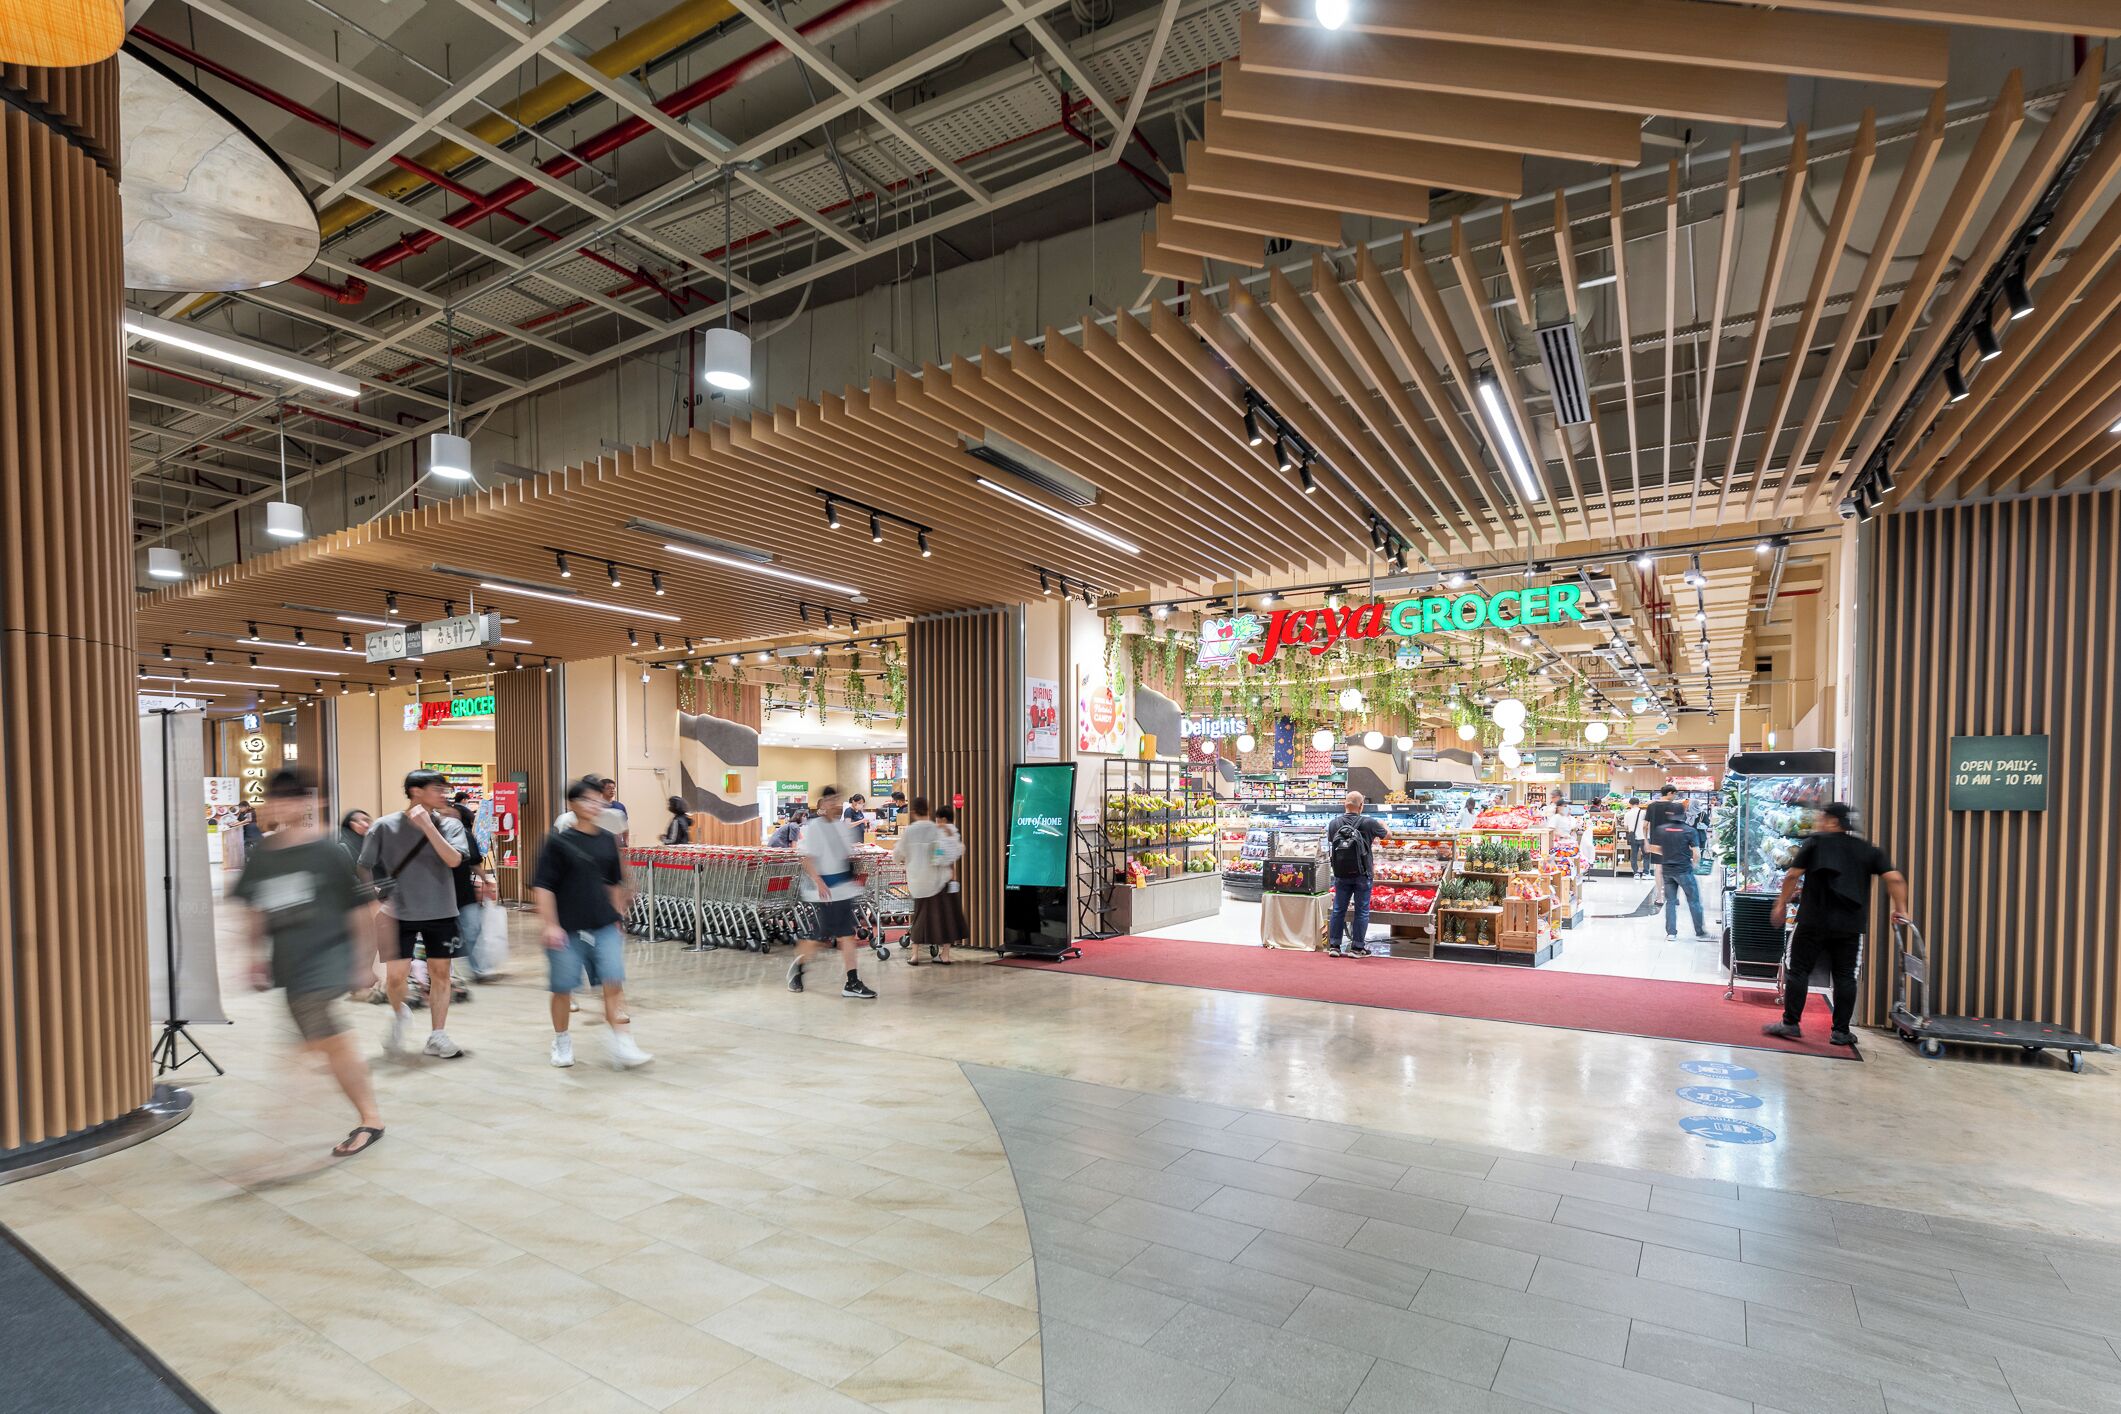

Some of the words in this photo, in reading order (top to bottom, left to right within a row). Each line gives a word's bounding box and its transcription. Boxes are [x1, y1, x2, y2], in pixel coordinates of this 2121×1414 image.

[683, 392, 703, 409] SD
[1248, 603, 1387, 666] Jaya
[1390, 584, 1583, 636] GROCER
[407, 631, 421, 641] MAIN
[1033, 687, 1053, 700] HIRING
[417, 700, 452, 731] Jaya
[451, 695, 496, 718] GROCER
[1180, 716, 1247, 739] Delights
[1960, 760, 1993, 772] OPEN
[1996, 759, 2038, 772] DAILY:
[1955, 774, 1969, 785] 10
[1971, 774, 1991, 785] AM
[2005, 774, 2019, 785] 10
[2023, 774, 2043, 785] PM
[781, 783, 804, 791] GrabMart
[1017, 817, 1032, 826] OUT
[1031, 813, 1043, 828] of
[1042, 817, 1062, 826] HOME
